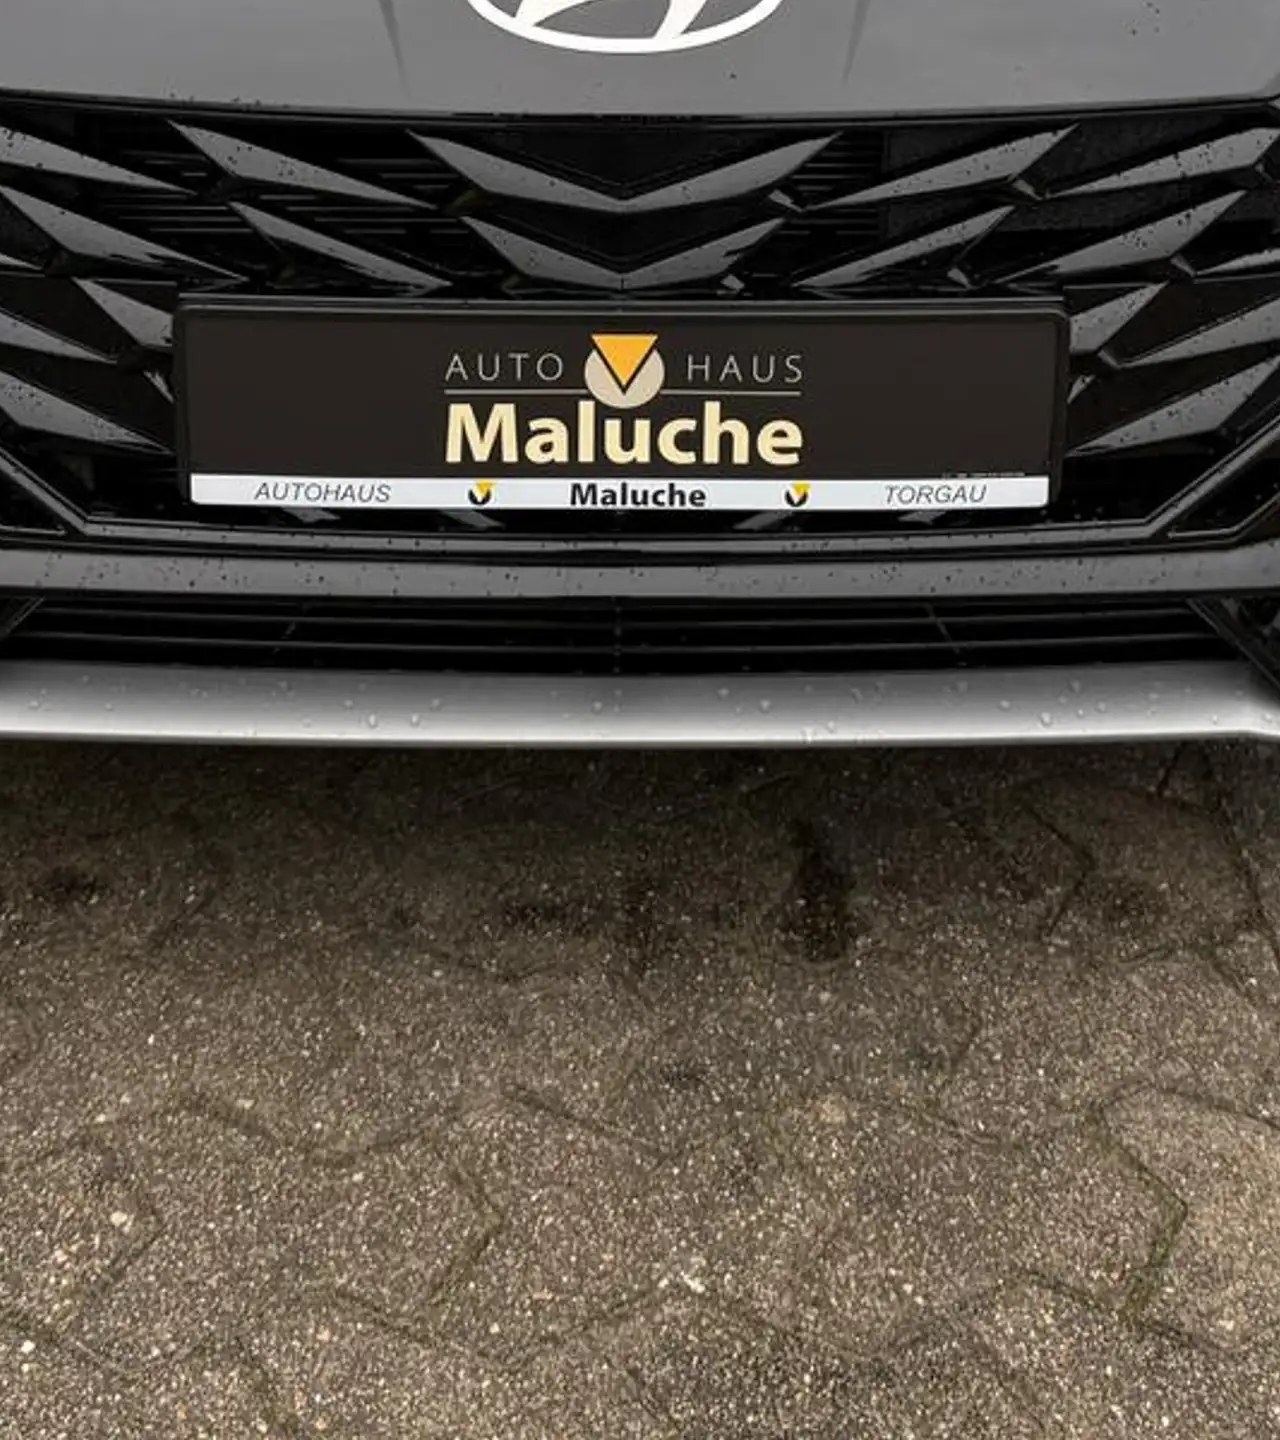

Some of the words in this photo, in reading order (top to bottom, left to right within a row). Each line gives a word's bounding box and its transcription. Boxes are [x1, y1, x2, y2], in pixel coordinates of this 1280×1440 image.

[445, 353, 563, 382] AUTO
[687, 354, 802, 383] HAUS
[445, 400, 803, 465] Maluche
[254, 482, 391, 502] AUTOHAUS
[570, 482, 706, 507] Maluche
[884, 484, 987, 504] TORGAU
